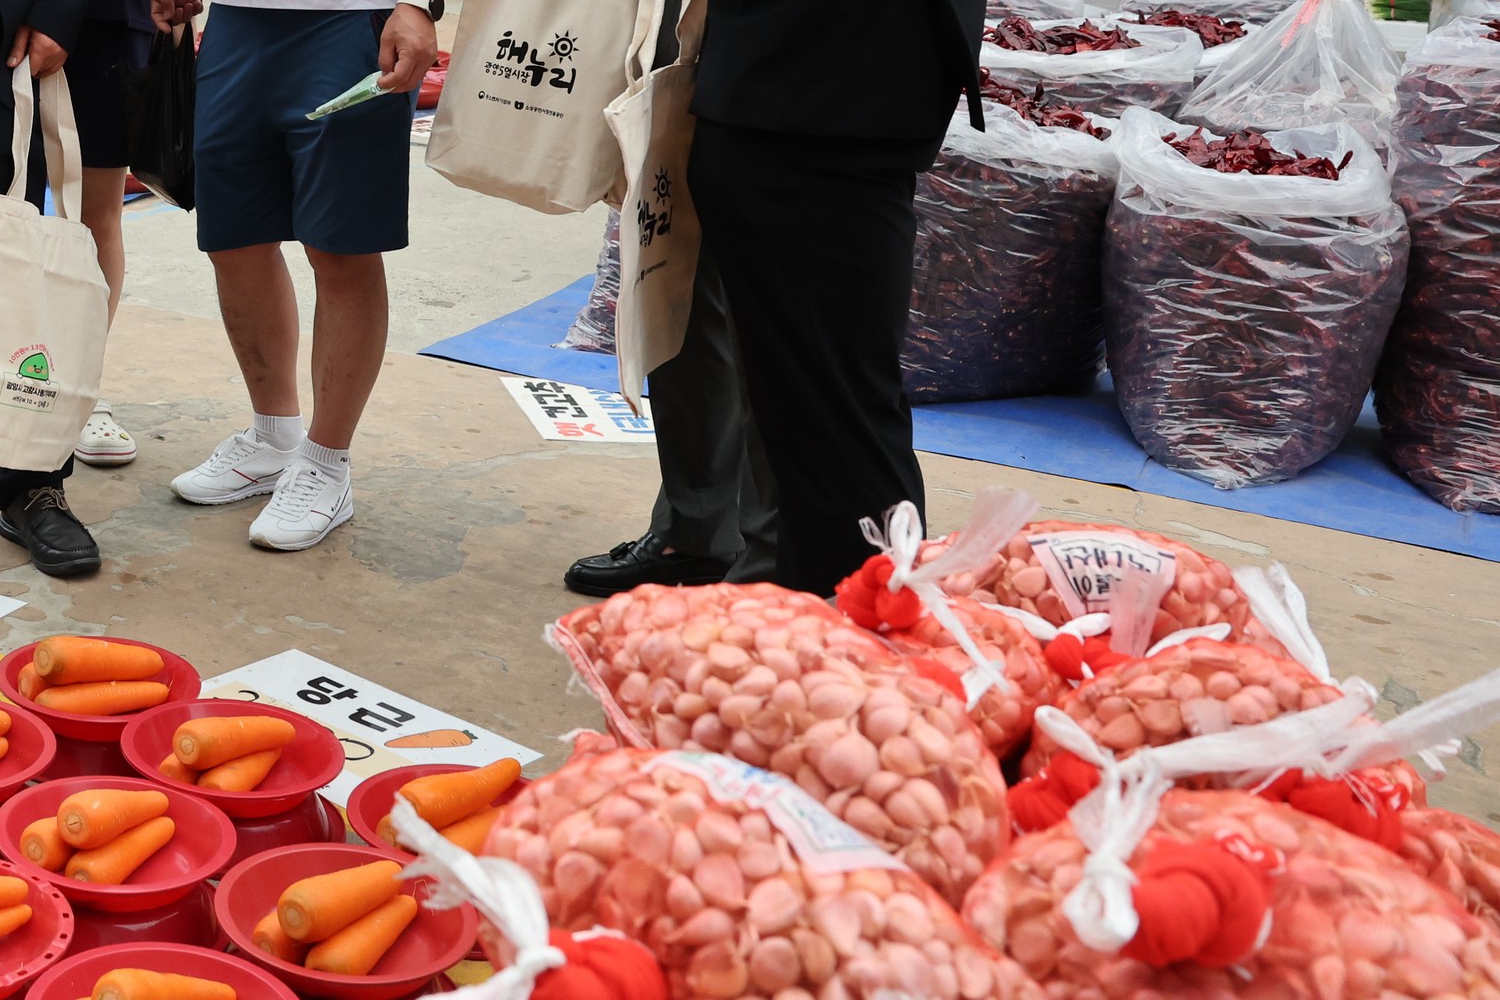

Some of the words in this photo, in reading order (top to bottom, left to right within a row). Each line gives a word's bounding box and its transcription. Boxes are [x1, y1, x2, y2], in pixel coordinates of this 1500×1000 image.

[496, 31, 576, 94] 해누리
[524, 381, 588, 418] 건고추
[296, 676, 416, 733] 당근
